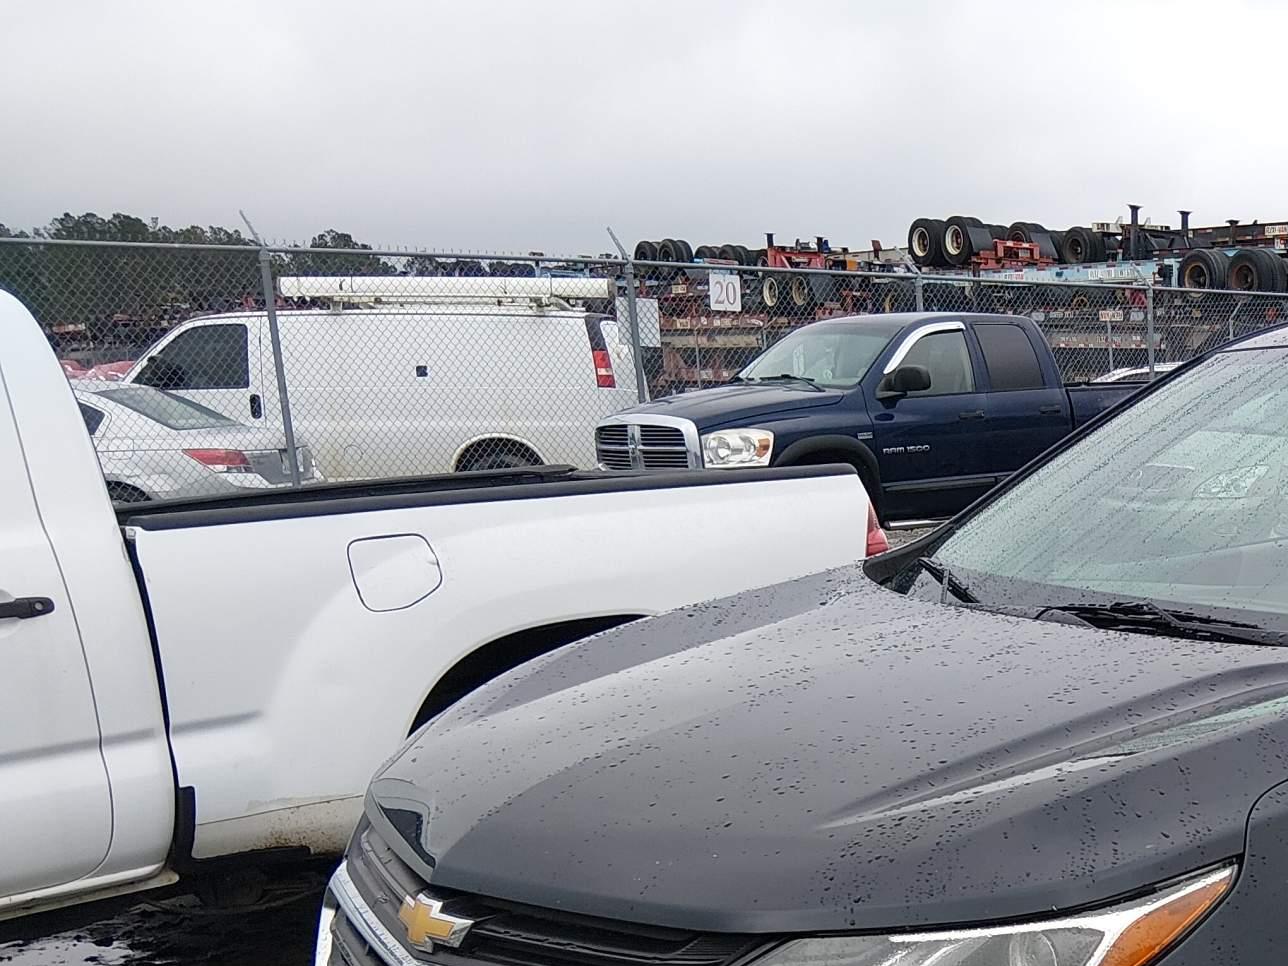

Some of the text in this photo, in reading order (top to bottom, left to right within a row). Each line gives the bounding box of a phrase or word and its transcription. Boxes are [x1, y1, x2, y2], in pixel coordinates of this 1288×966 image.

[713, 280, 737, 305] 20
[883, 444, 930, 455] RAM 1500
